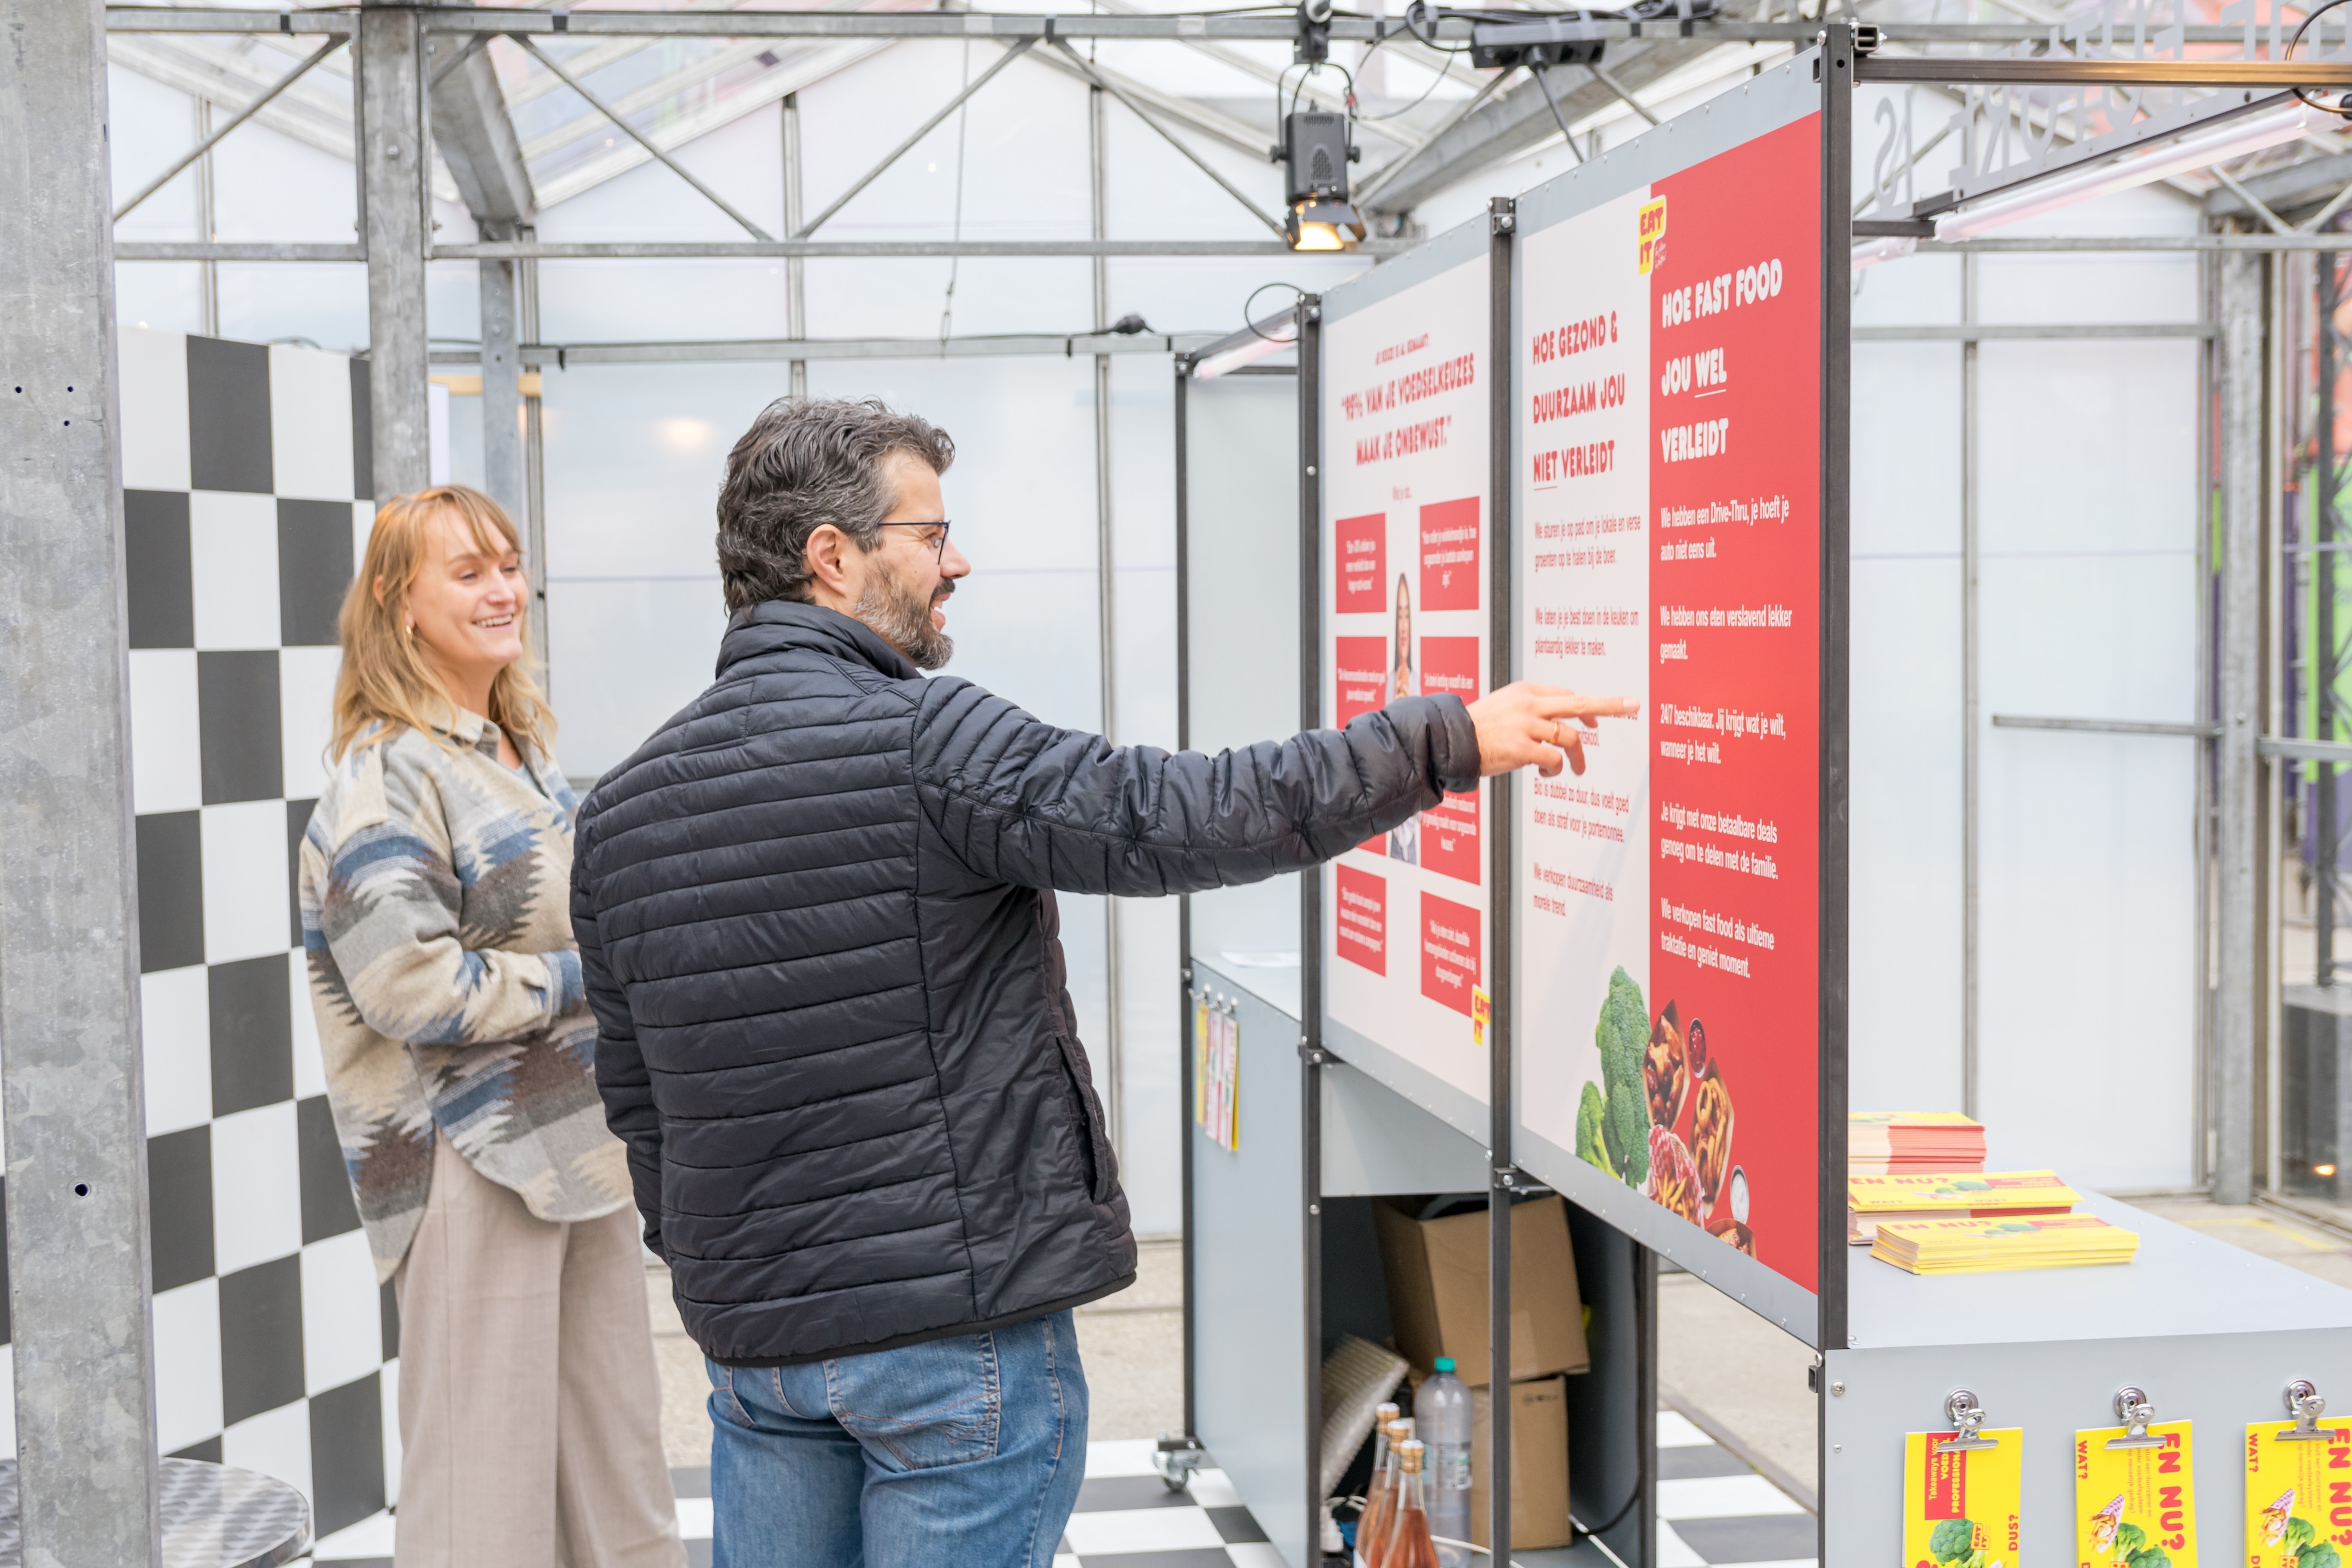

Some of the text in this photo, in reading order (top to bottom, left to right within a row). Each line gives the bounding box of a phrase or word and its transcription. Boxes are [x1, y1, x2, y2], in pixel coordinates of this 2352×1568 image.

[1641, 207, 1663, 236] EAT
[1640, 241, 1653, 266] IT
[1661, 258, 1783, 329] HOE FAST FOOD
[1532, 310, 1618, 364] HOE GEZOND &
[1366, 386, 1383, 414] VAN
[1386, 380, 1395, 409] JE
[1399, 353, 1475, 403] VOEDSELKEUZES
[1661, 347, 1727, 397] JOU WEL
[1532, 374, 1626, 424] DUURZAAM JOU
[1356, 437, 1380, 466] MAAK
[1383, 432, 1393, 460] JE
[1532, 439, 1615, 482] NIET VERLEIDT
[1661, 418, 1729, 463] VERLEIDT
[1661, 494, 1790, 528] We hebben een Drive-Thru, je hoeft je
[1660, 536, 1716, 561] auto niet eens uit.
[1659, 604, 1792, 627] We hebben ons eten verslavend lekker
[1660, 639, 1687, 664] gemaakt.
[1660, 703, 1786, 740] 24/7 beschikbaar. Jij krijgt wat je wilt,
[1660, 739, 1721, 765] wanneer je het wilt.
[1661, 801, 1778, 843] Je krijgt met onze betaalbare deals
[1661, 838, 1778, 879] genoeg om te delen met de familie.
[1661, 897, 1775, 950] We verkopen fast food als ultieme
[1661, 931, 1750, 978] traktatie en geniet moment.
[1941, 1437, 1950, 1480] VOEDL
[2077, 1440, 2088, 1480] WAT?
[2248, 1433, 2259, 1473] WAT?
[1928, 1457, 1939, 1501] Takeaways
[2157, 1433, 2185, 1551] EN NU?
[2328, 1429, 2352, 1546] EN NU?
[1981, 1536, 1987, 1548] IT
[2009, 1514, 2018, 1551] DUS?
